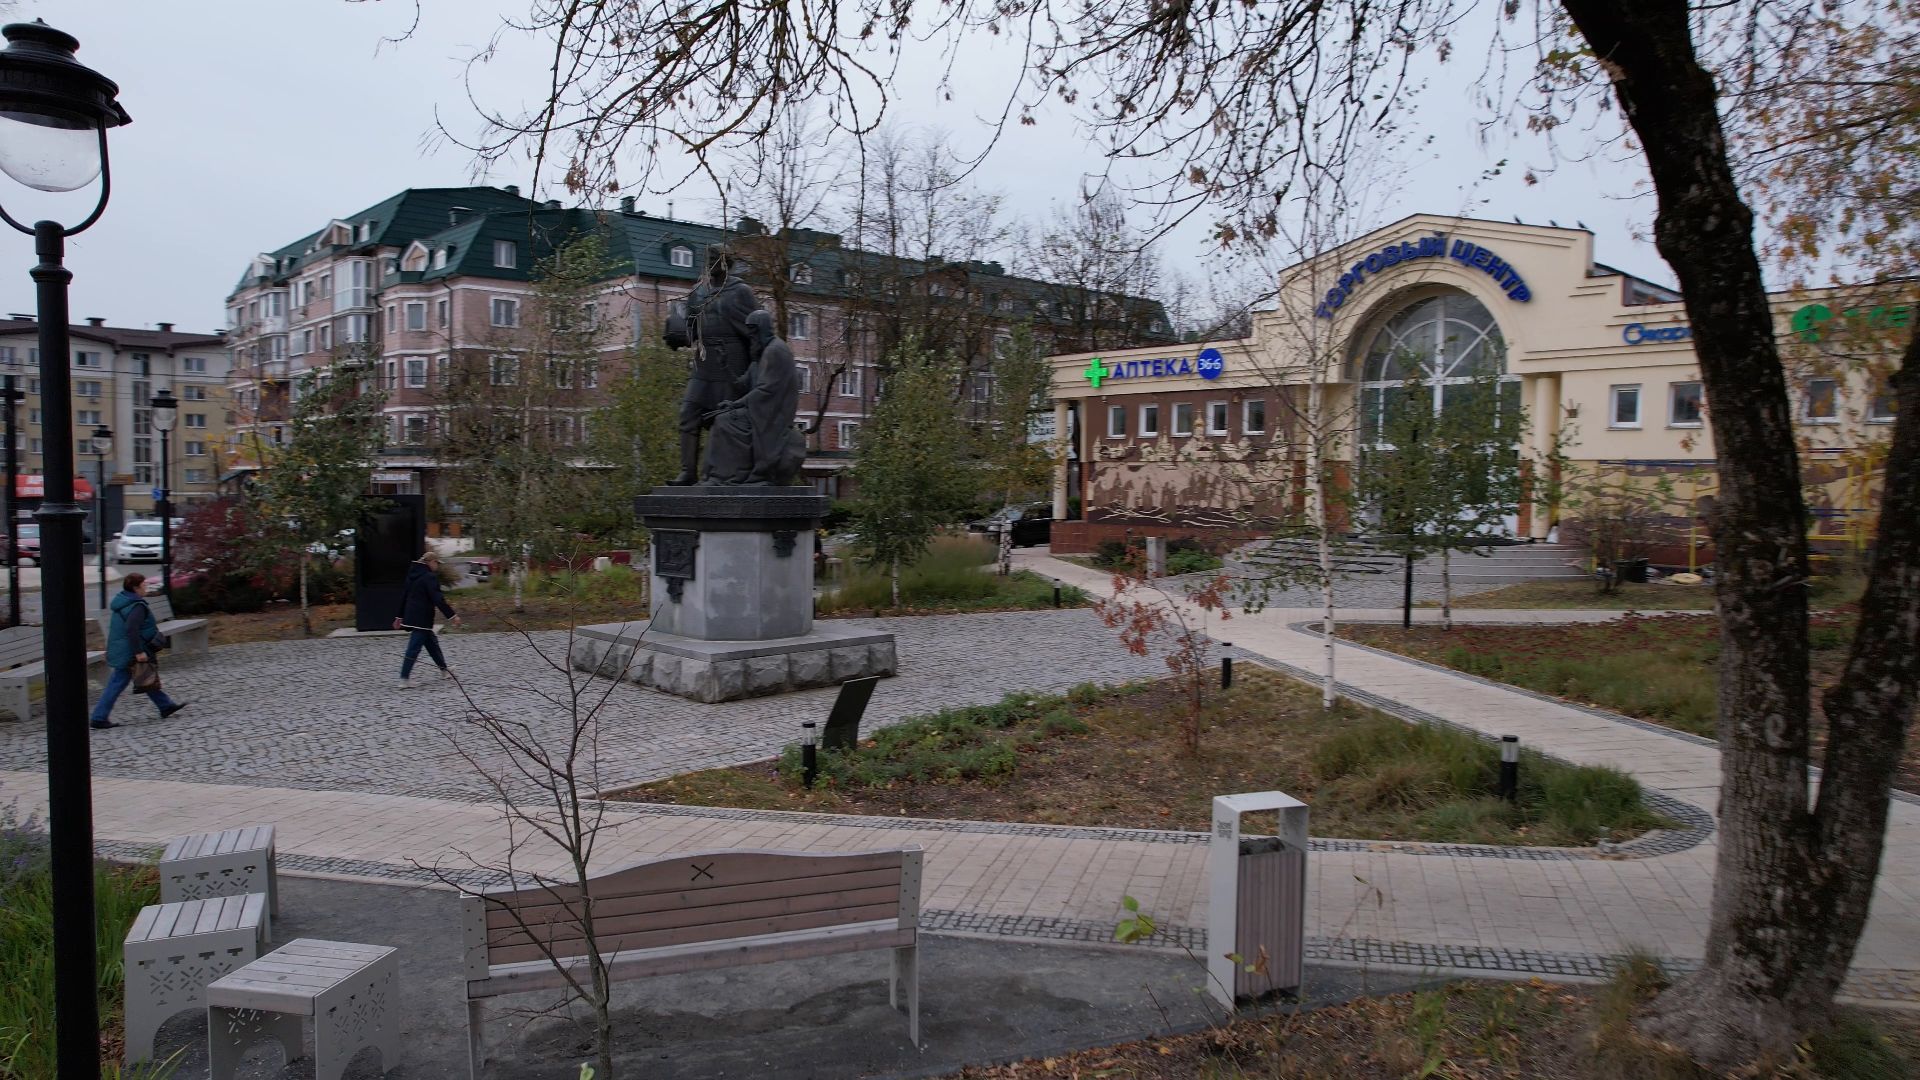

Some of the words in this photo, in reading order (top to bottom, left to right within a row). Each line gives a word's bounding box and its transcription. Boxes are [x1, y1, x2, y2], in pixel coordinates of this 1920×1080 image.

[1315, 231, 1449, 320] ТОРГОВЫЙ
[1450, 239, 1533, 303] ЦЕНТР
[1112, 357, 1192, 380] АПТЕКА
